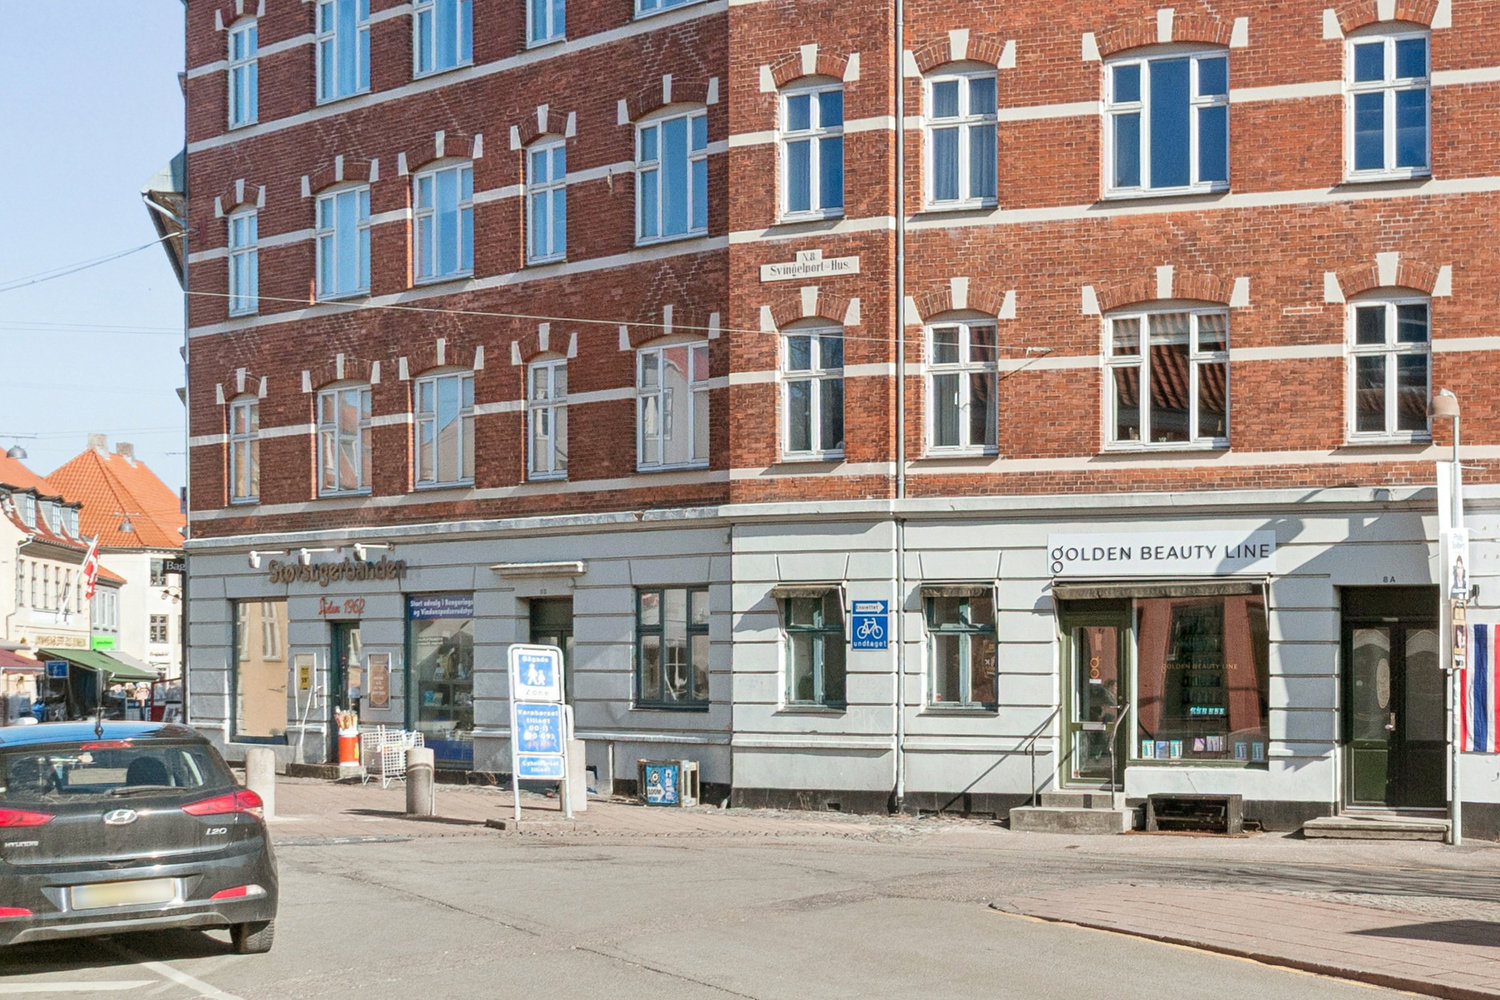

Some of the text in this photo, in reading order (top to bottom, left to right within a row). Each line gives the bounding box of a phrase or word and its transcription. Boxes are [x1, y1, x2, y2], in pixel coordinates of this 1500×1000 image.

[1140, 544, 1217, 561] BEAUTY
[1225, 543, 1270, 559] LINE
[853, 640, 887, 649] undtaget
